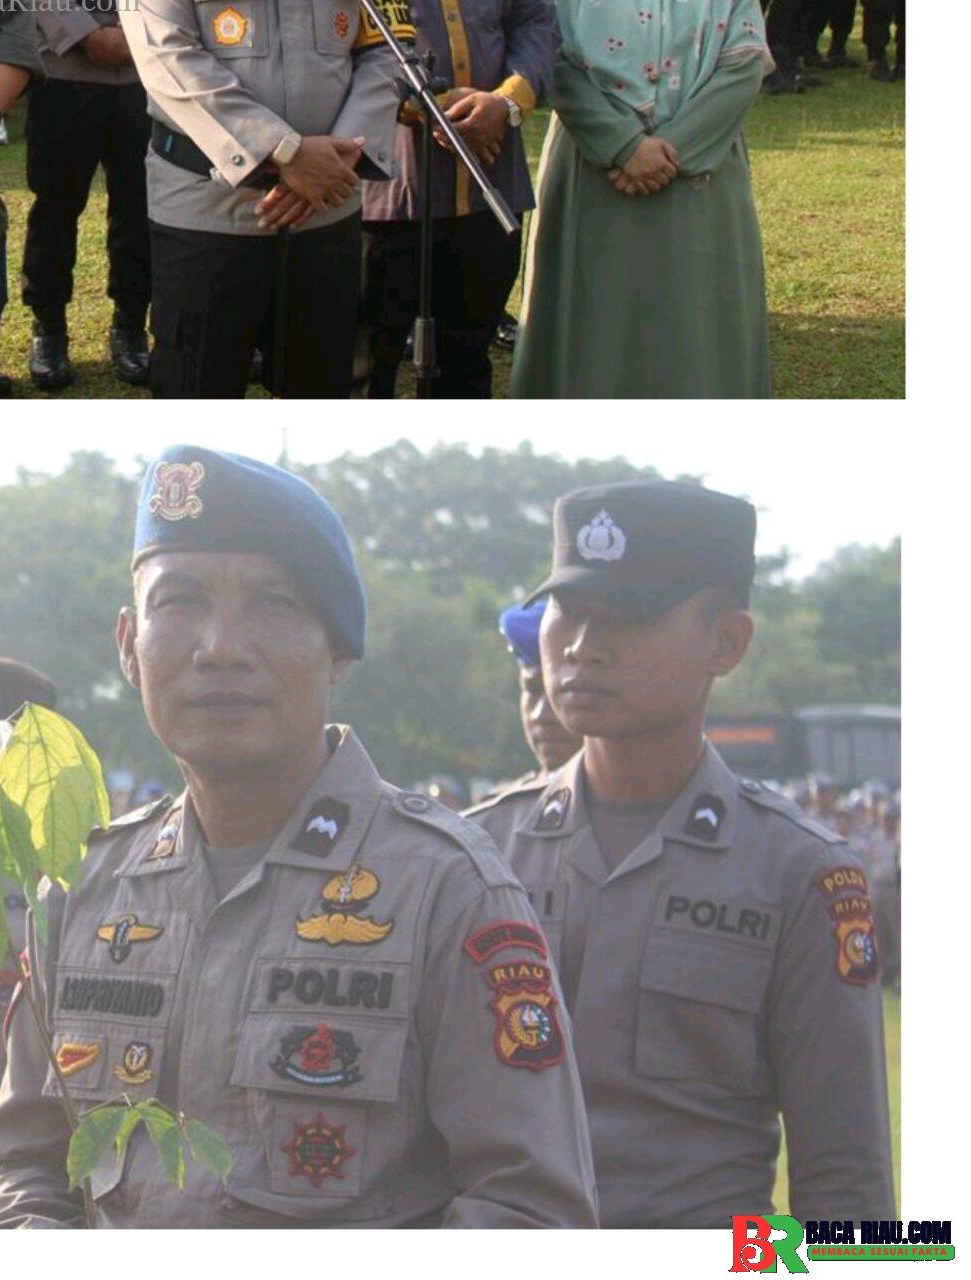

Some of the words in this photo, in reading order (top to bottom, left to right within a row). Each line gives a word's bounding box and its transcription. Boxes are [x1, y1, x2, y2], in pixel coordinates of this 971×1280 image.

[665, 895, 770, 941] POLRI
[266, 966, 394, 1010] POLRI
[493, 964, 545, 983] RIAU
